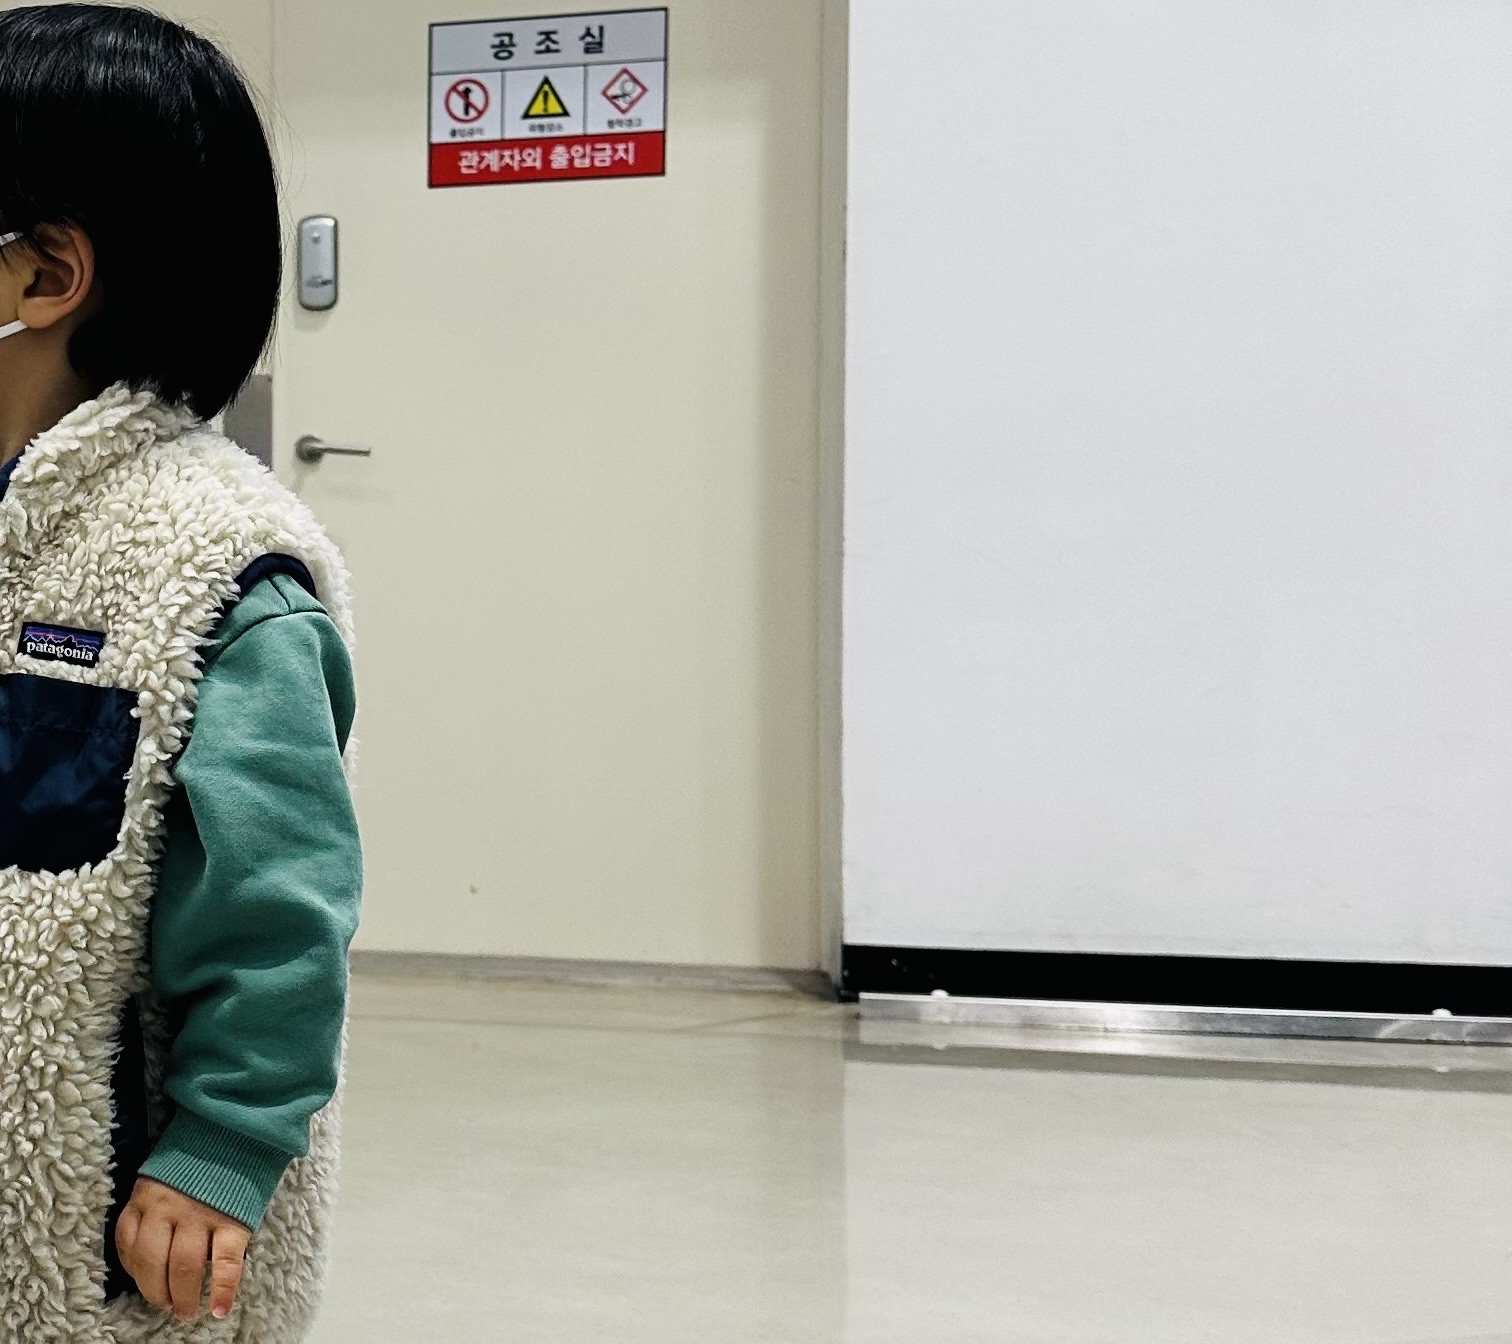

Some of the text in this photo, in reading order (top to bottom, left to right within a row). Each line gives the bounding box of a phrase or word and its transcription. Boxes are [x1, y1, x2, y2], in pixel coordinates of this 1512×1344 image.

[457, 140, 636, 175] 관계자외 출입금지
[26, 641, 94, 662] patagonia
